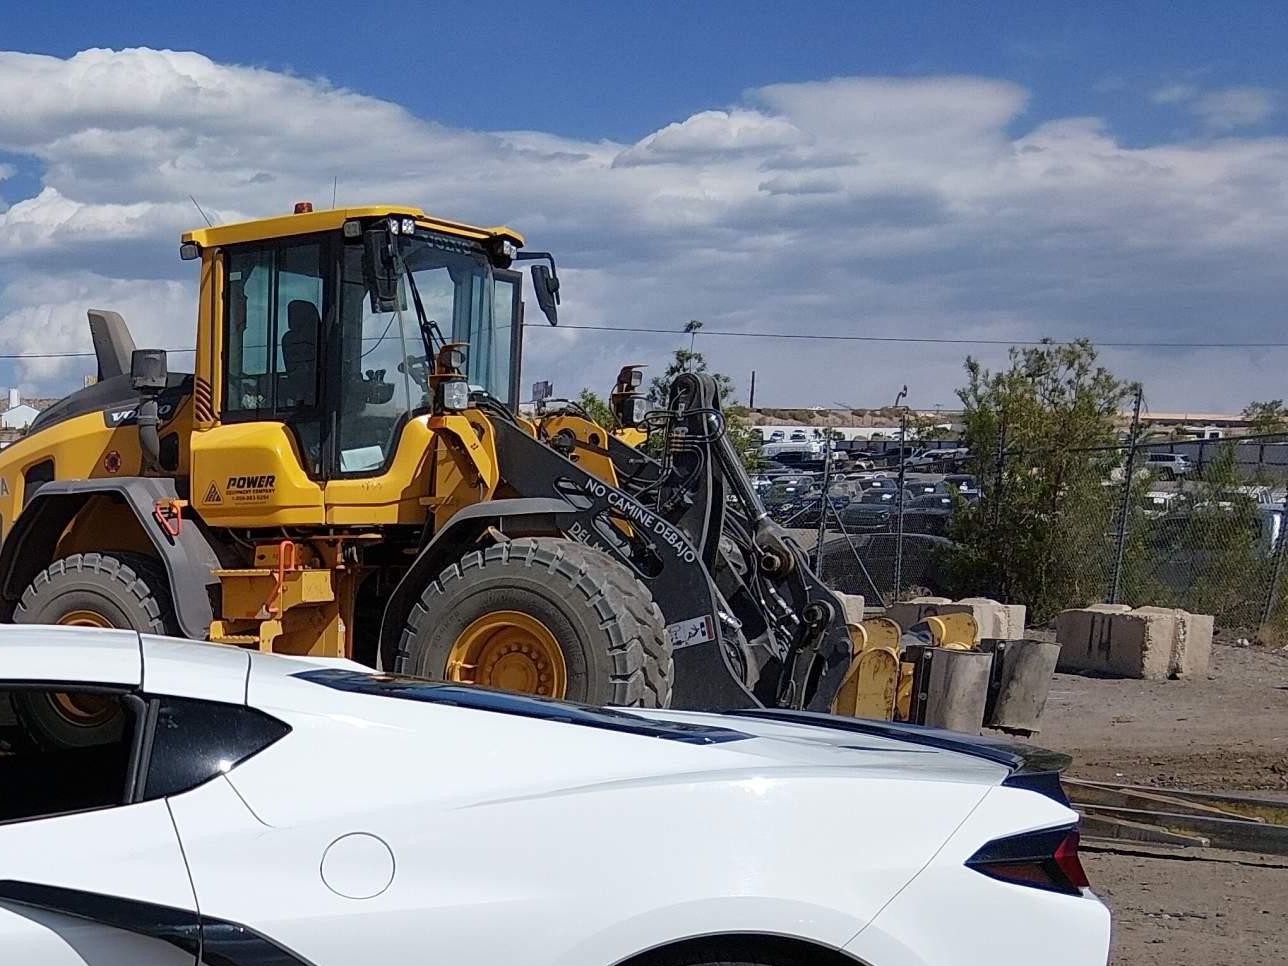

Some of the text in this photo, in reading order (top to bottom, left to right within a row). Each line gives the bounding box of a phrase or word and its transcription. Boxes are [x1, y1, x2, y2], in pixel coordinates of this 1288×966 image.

[226, 475, 276, 490] POWER
[570, 521, 592, 546] DEL
[585, 479, 606, 497] NO
[607, 493, 655, 528] CAMINE
[653, 521, 695, 563] DEBAJO
